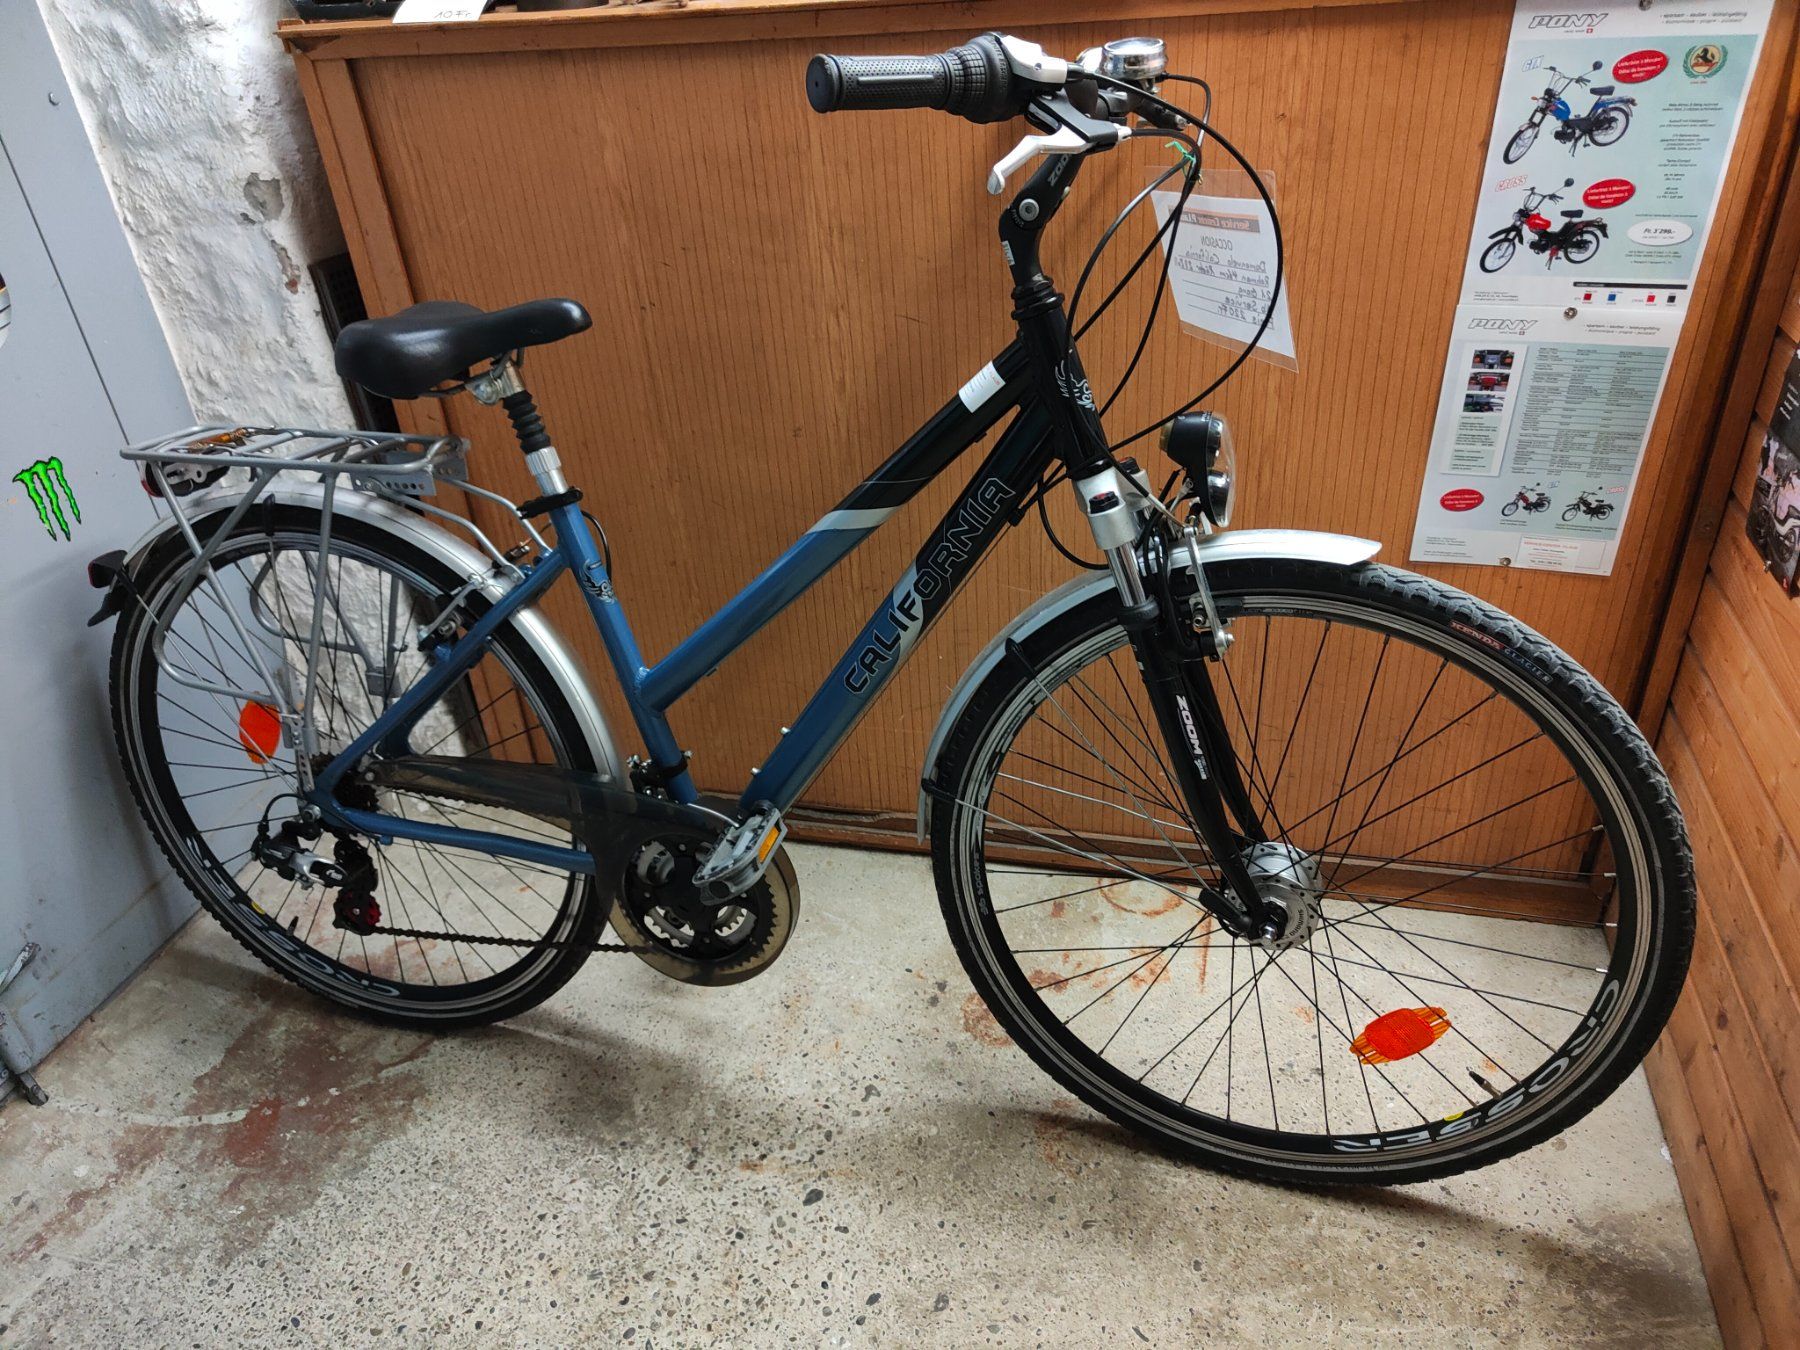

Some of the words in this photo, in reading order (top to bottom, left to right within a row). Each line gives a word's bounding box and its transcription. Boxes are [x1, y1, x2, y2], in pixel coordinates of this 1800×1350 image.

[434, 10, 453, 19] 10
[1528, 12, 1609, 29] PONY
[1047, 153, 1072, 187] ZOO
[1468, 317, 1539, 330] PONY
[843, 477, 1016, 695] CALIFORNIA
[1451, 621, 1504, 650] KENDA
[1504, 648, 1551, 684] GLACIER
[1175, 694, 1203, 755] ZOOM
[1332, 979, 1619, 1152] CROSSER
